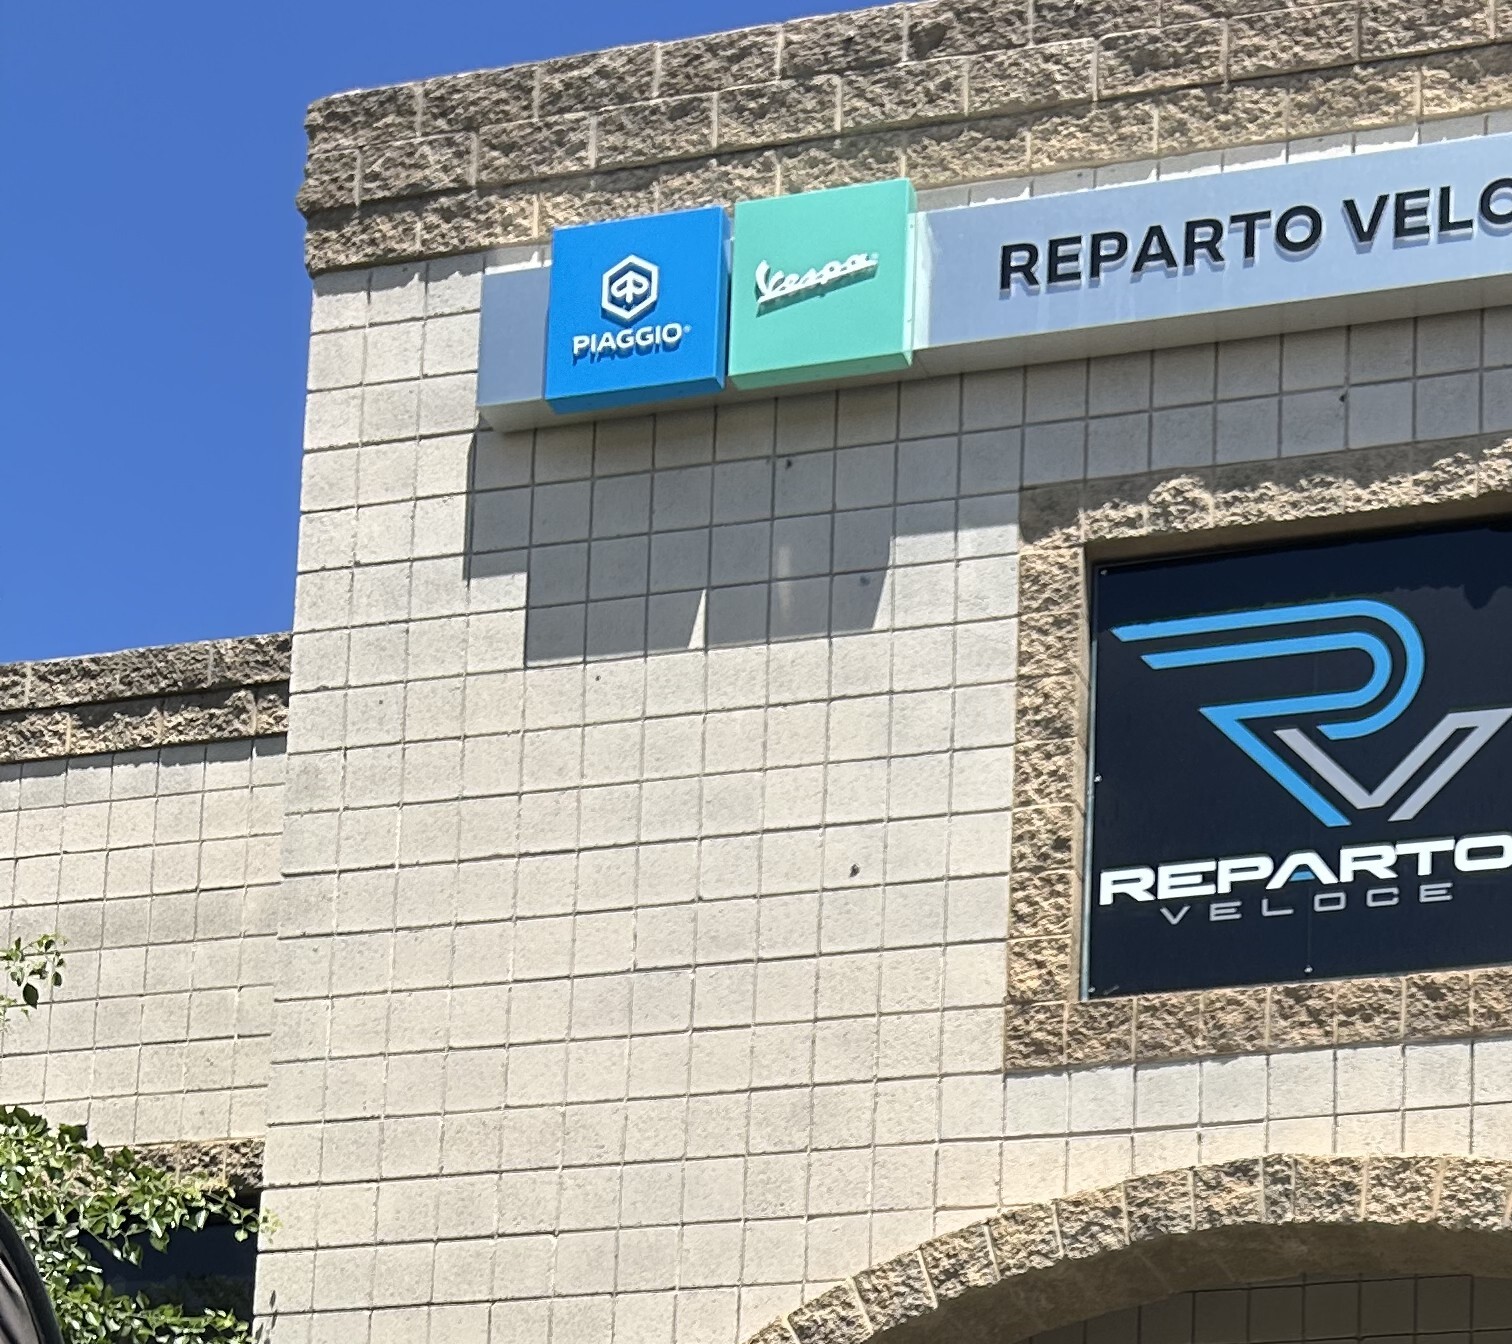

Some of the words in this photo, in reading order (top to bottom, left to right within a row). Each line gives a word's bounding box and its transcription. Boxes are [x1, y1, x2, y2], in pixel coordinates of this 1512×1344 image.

[1001, 205, 1323, 290] REPARTO
[755, 257, 880, 304] Vespa
[572, 322, 683, 356] PIAGGIO
[1160, 882, 1454, 926] VELOCE
